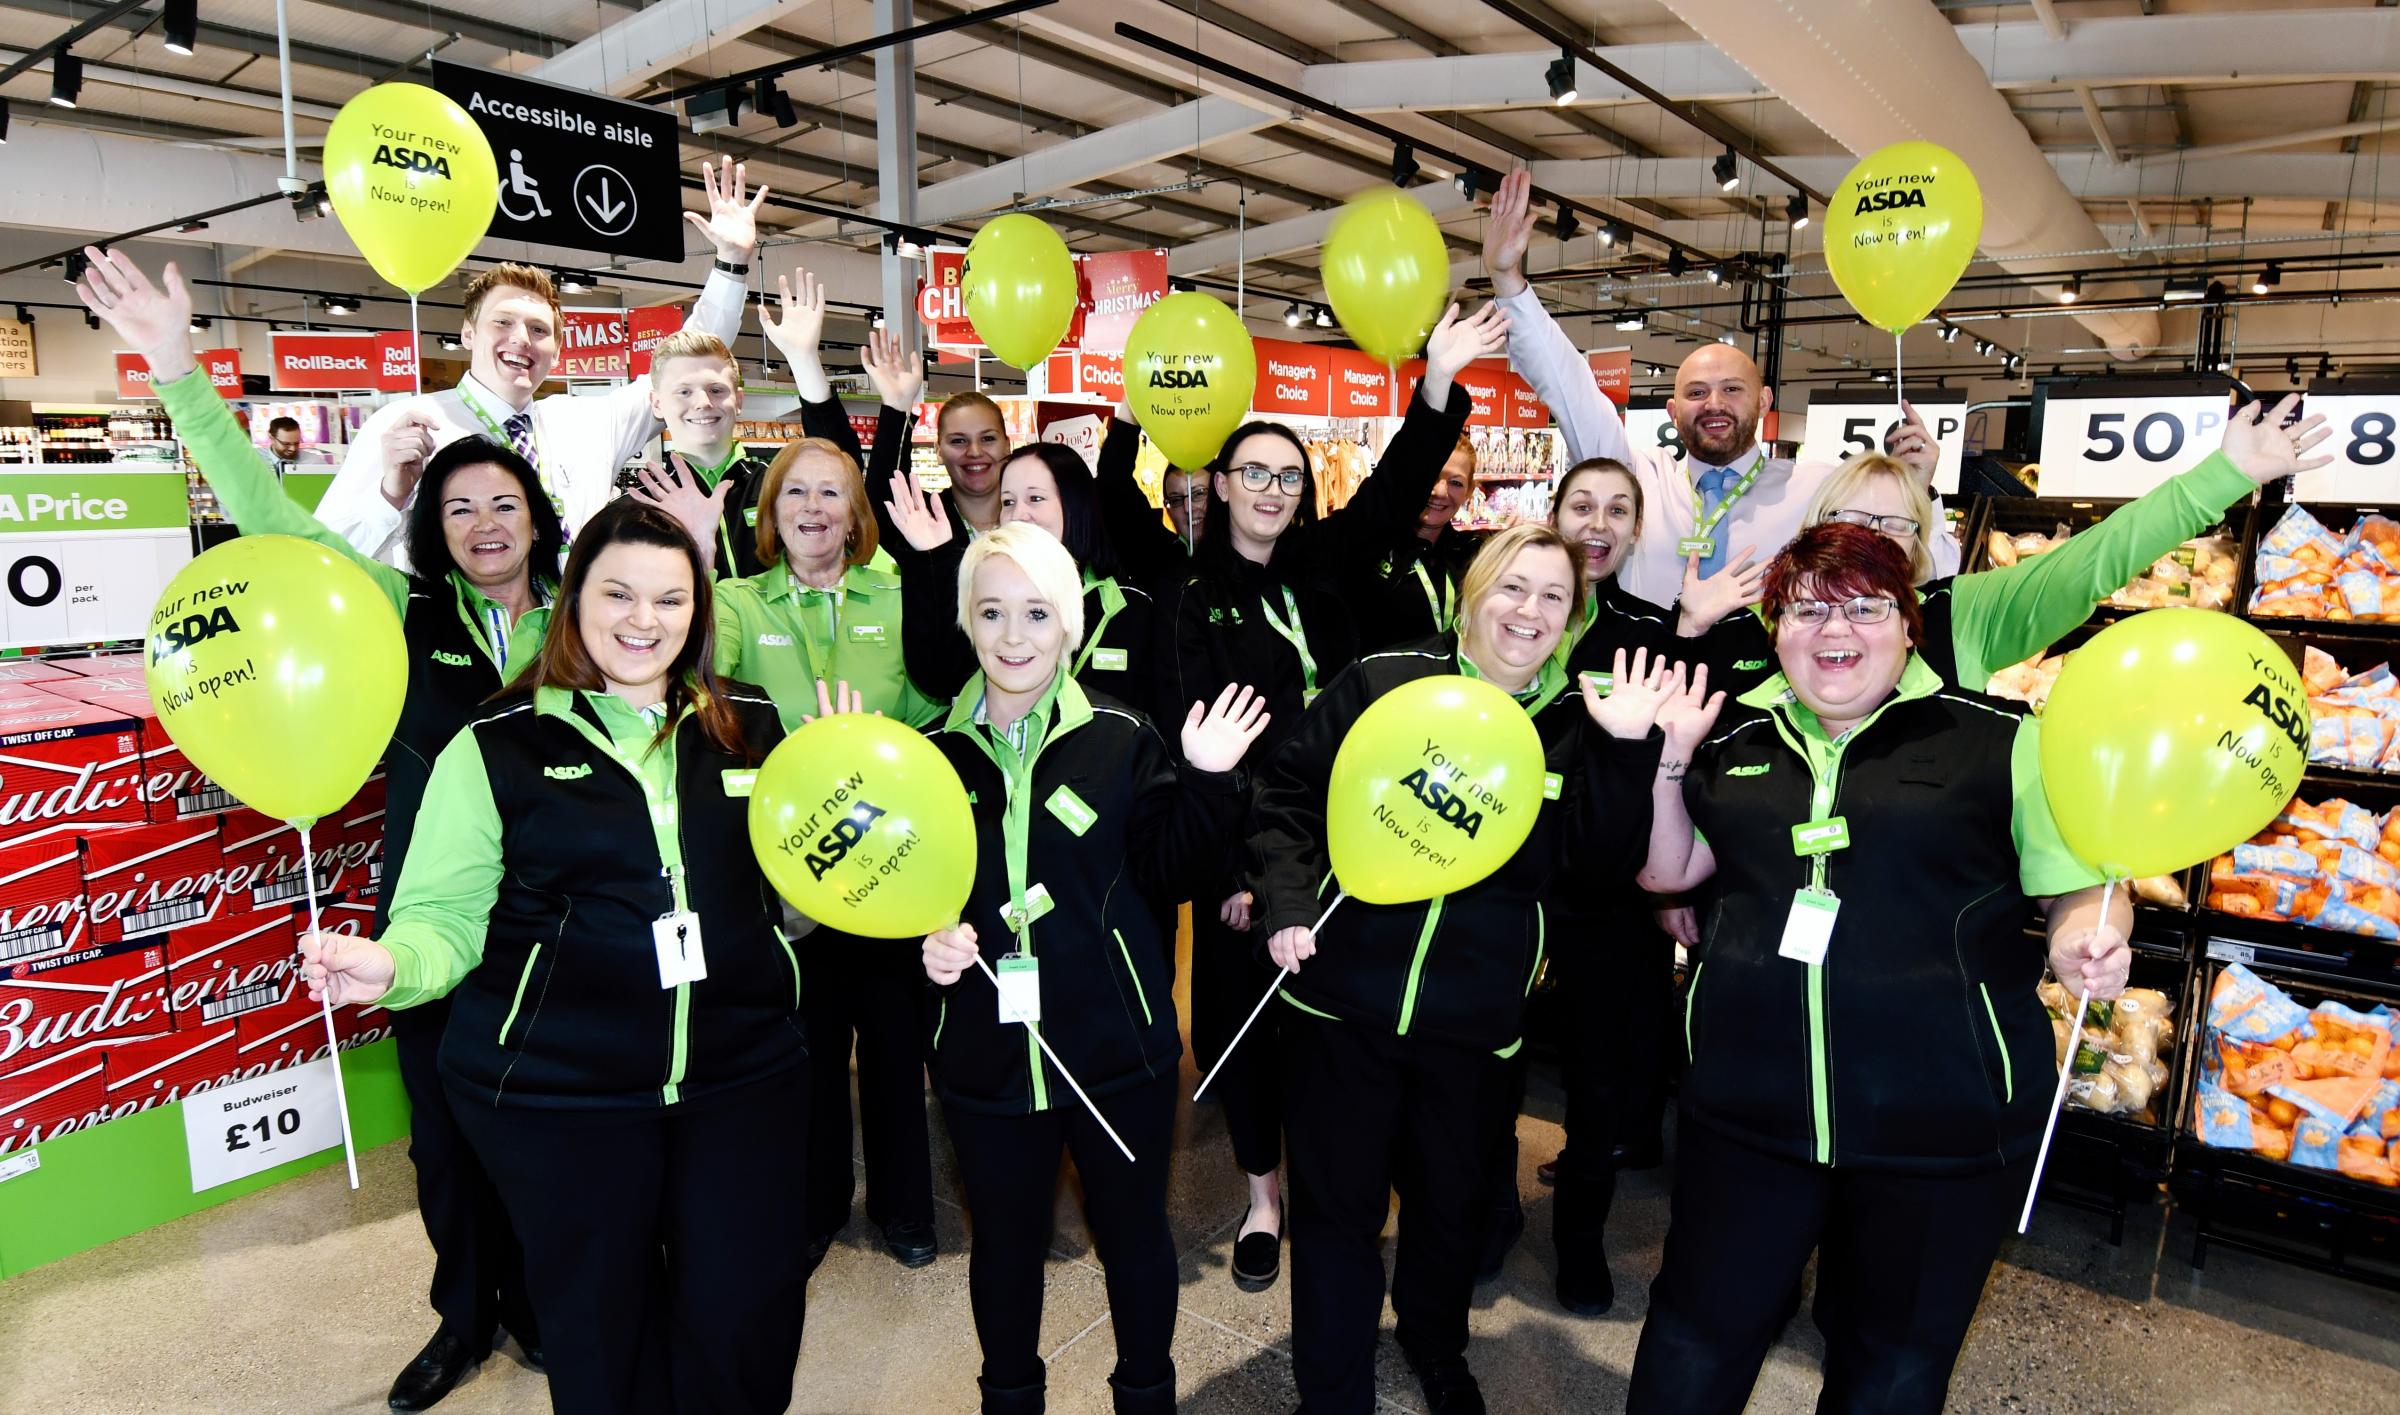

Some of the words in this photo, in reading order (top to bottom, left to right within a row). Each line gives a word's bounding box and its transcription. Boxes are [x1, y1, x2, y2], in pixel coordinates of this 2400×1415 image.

[468, 91, 597, 137] Accessible
[603, 121, 653, 149] aisle
[371, 123, 416, 142] Your
[422, 136, 461, 155] new
[372, 144, 452, 180] ASDA
[405, 175, 415, 189] is
[1856, 176, 1892, 192] Your
[1899, 174, 1935, 184] new
[371, 185, 405, 203] Now
[410, 199, 451, 213] open!
[1855, 189, 1926, 216] ASDA
[1882, 216, 1893, 227] is
[1855, 233, 1883, 249] Now
[1106, 282, 1138, 295] Merry
[385, 346, 411, 361] Roll
[1147, 351, 1178, 364] Your
[1184, 354, 1213, 364] new
[212, 361, 234, 374] Roll
[284, 356, 368, 370] RollBack
[382, 361, 416, 376] Back
[1268, 360, 1316, 380] Manager's
[1593, 368, 1626, 376] Manager's
[211, 375, 239, 387] Back
[1083, 365, 1124, 386] Choic
[1149, 370, 1208, 388] ASDA
[1344, 369, 1385, 387] Manager's
[1597, 378, 1620, 387] Choice
[1173, 393, 1182, 403] is
[1275, 384, 1308, 401] Choice
[1350, 391, 1378, 406] Choice
[1465, 383, 1496, 399] Manager's
[1151, 404, 1175, 416] Now
[1180, 403, 1210, 420] open!
[1518, 406, 1537, 418] Choice
[1083, 427, 1093, 448] 2
[1937, 418, 1958, 440] P
[2082, 412, 2184, 461] 50
[2195, 412, 2219, 436] P
[2345, 412, 2396, 465] 8
[27, 493, 128, 521] Price
[75, 585, 94, 593] per
[192, 581, 249, 605] new
[72, 595, 99, 604] pack
[152, 605, 241, 668] ASDA
[758, 633, 793, 646] ASDA
[431, 649, 472, 666] ASDA
[1732, 658, 1767, 671] ASDA
[184, 659, 198, 675] is
[2248, 652, 2296, 696] Your
[163, 686, 194, 716] Now
[199, 658, 257, 699] open!
[2242, 683, 2310, 765] ASDA
[1, 734, 33, 746] TWIST
[34, 730, 53, 742] OFF
[53, 728, 76, 739] CAP.
[117, 735, 129, 743] 24
[2270, 737, 2282, 759] is
[543, 763, 593, 780] ASDA
[1422, 737, 1468, 783] Your
[1468, 781, 1508, 816] new
[1726, 763, 1771, 776] ASDA
[2217, 730, 2262, 768] Now
[2260, 767, 2289, 806] open!
[1399, 767, 1484, 840] ASDA
[778, 812, 820, 856] Your
[821, 771, 864, 815] new
[1416, 815, 1432, 834] is
[804, 800, 887, 882] ASDA
[1373, 804, 1410, 839] Now
[1410, 837, 1457, 870] open!
[843, 875, 880, 908] Now
[879, 829, 921, 875] open!
[854, 854, 873, 869] is
[276, 874, 293, 883] TWIST
[149, 901, 166, 910] TWIST
[166, 898, 179, 907] OFF
[20, 928, 34, 937] OFF
[33, 926, 48, 934] CAP.
[31, 957, 62, 972] TWIST
[64, 953, 81, 965] OFF
[82, 949, 104, 960] CAP.
[226, 989, 244, 997] TWIST
[223, 1084, 298, 1113] Budweiser
[226, 1108, 301, 1153] £10
